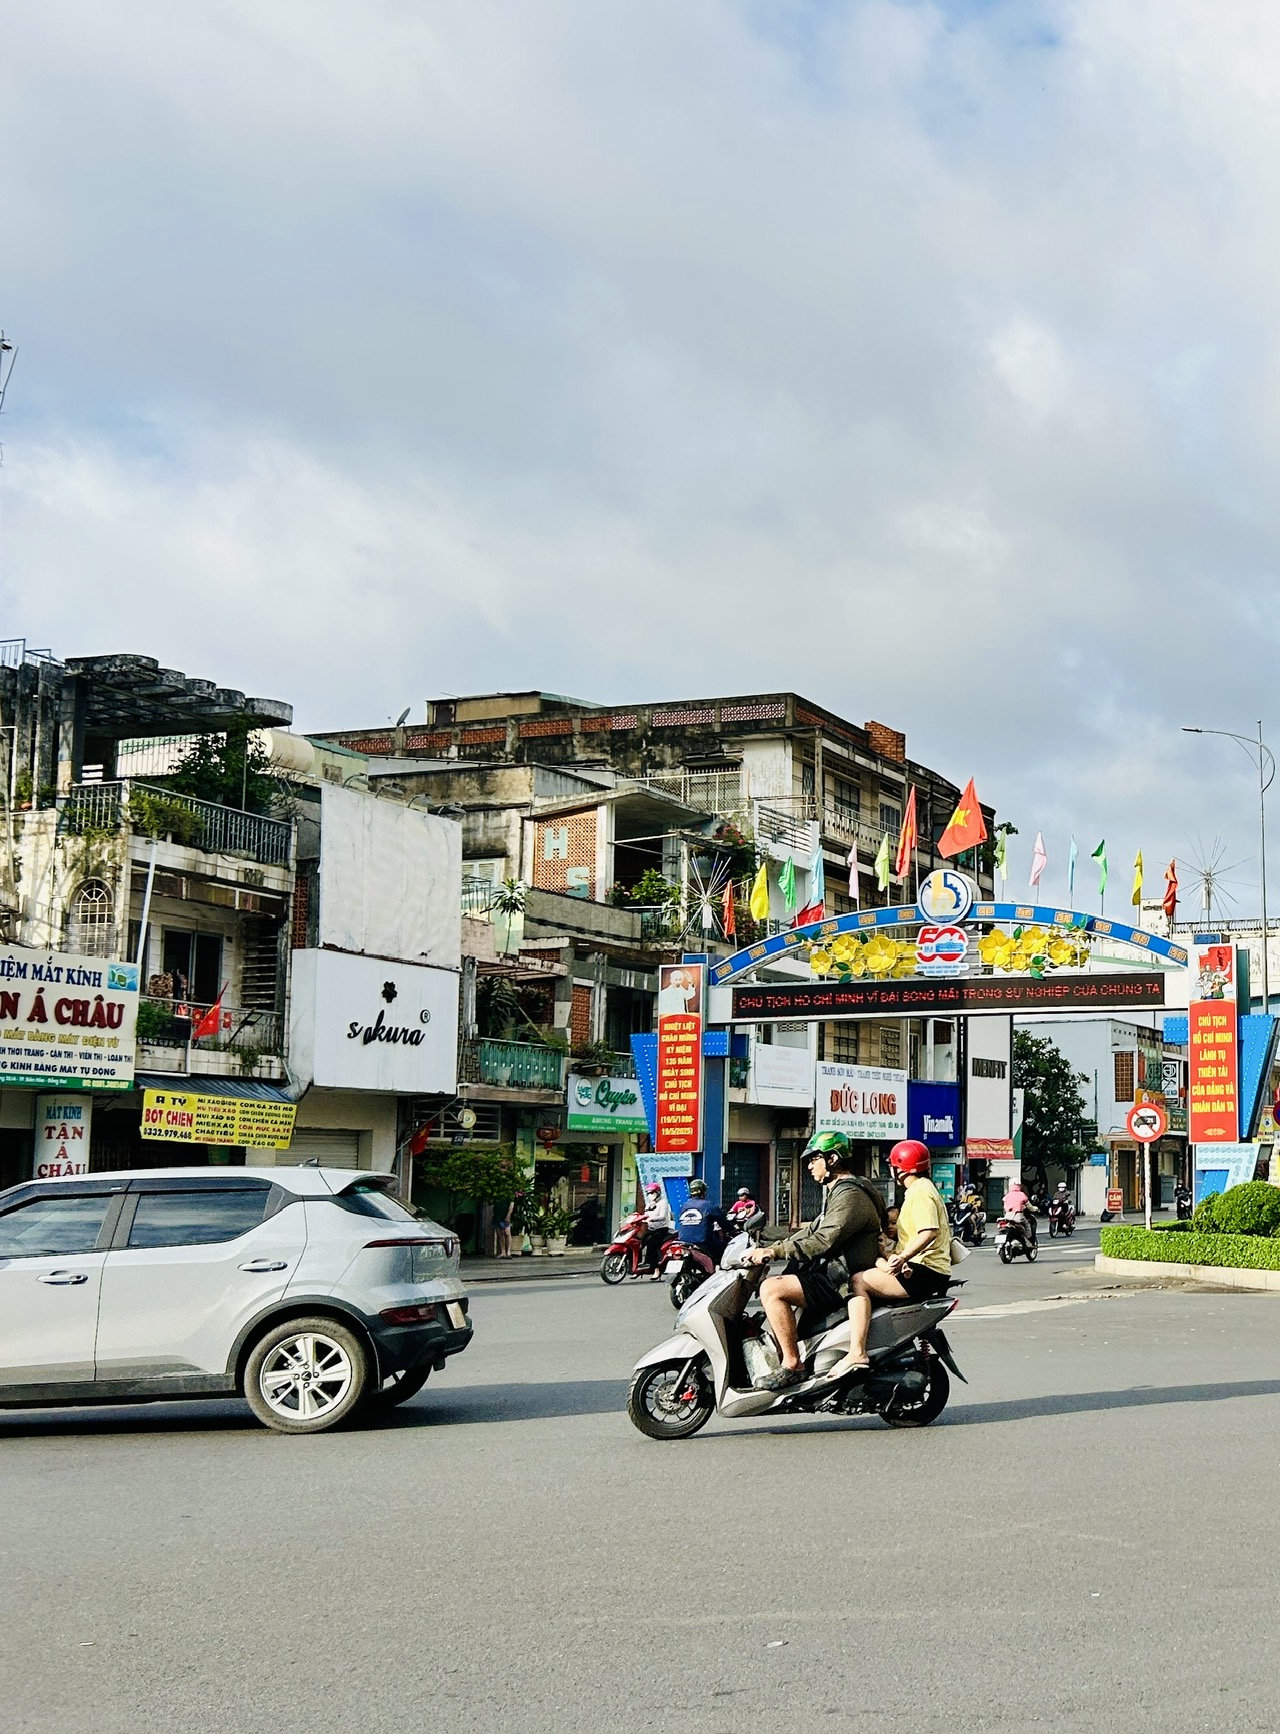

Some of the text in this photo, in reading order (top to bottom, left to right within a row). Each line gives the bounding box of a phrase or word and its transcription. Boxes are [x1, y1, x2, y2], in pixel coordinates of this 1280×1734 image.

[544, 827, 567, 860] H
[0, 955, 103, 988] IỆM MẮT KÍNH
[835, 992, 864, 1004] MINH
[963, 988, 1002, 1000] TRONG
[1146, 983, 1160, 994] TA
[27, 987, 48, 1023] Á
[54, 994, 125, 1029] CHÂU
[347, 1010, 426, 1046] sakura
[1212, 1015, 1227, 1028] TỊCH
[24, 1048, 45, 1057] TRANG
[972, 1057, 1007, 1080] MENFIT
[830, 1083, 897, 1115] ĐỨC LONG
[44, 1122, 84, 1140] TÂN
[923, 1115, 953, 1133] Vinamilk
[55, 1141, 68, 1158] Á
[37, 1161, 86, 1178] CHÂU
